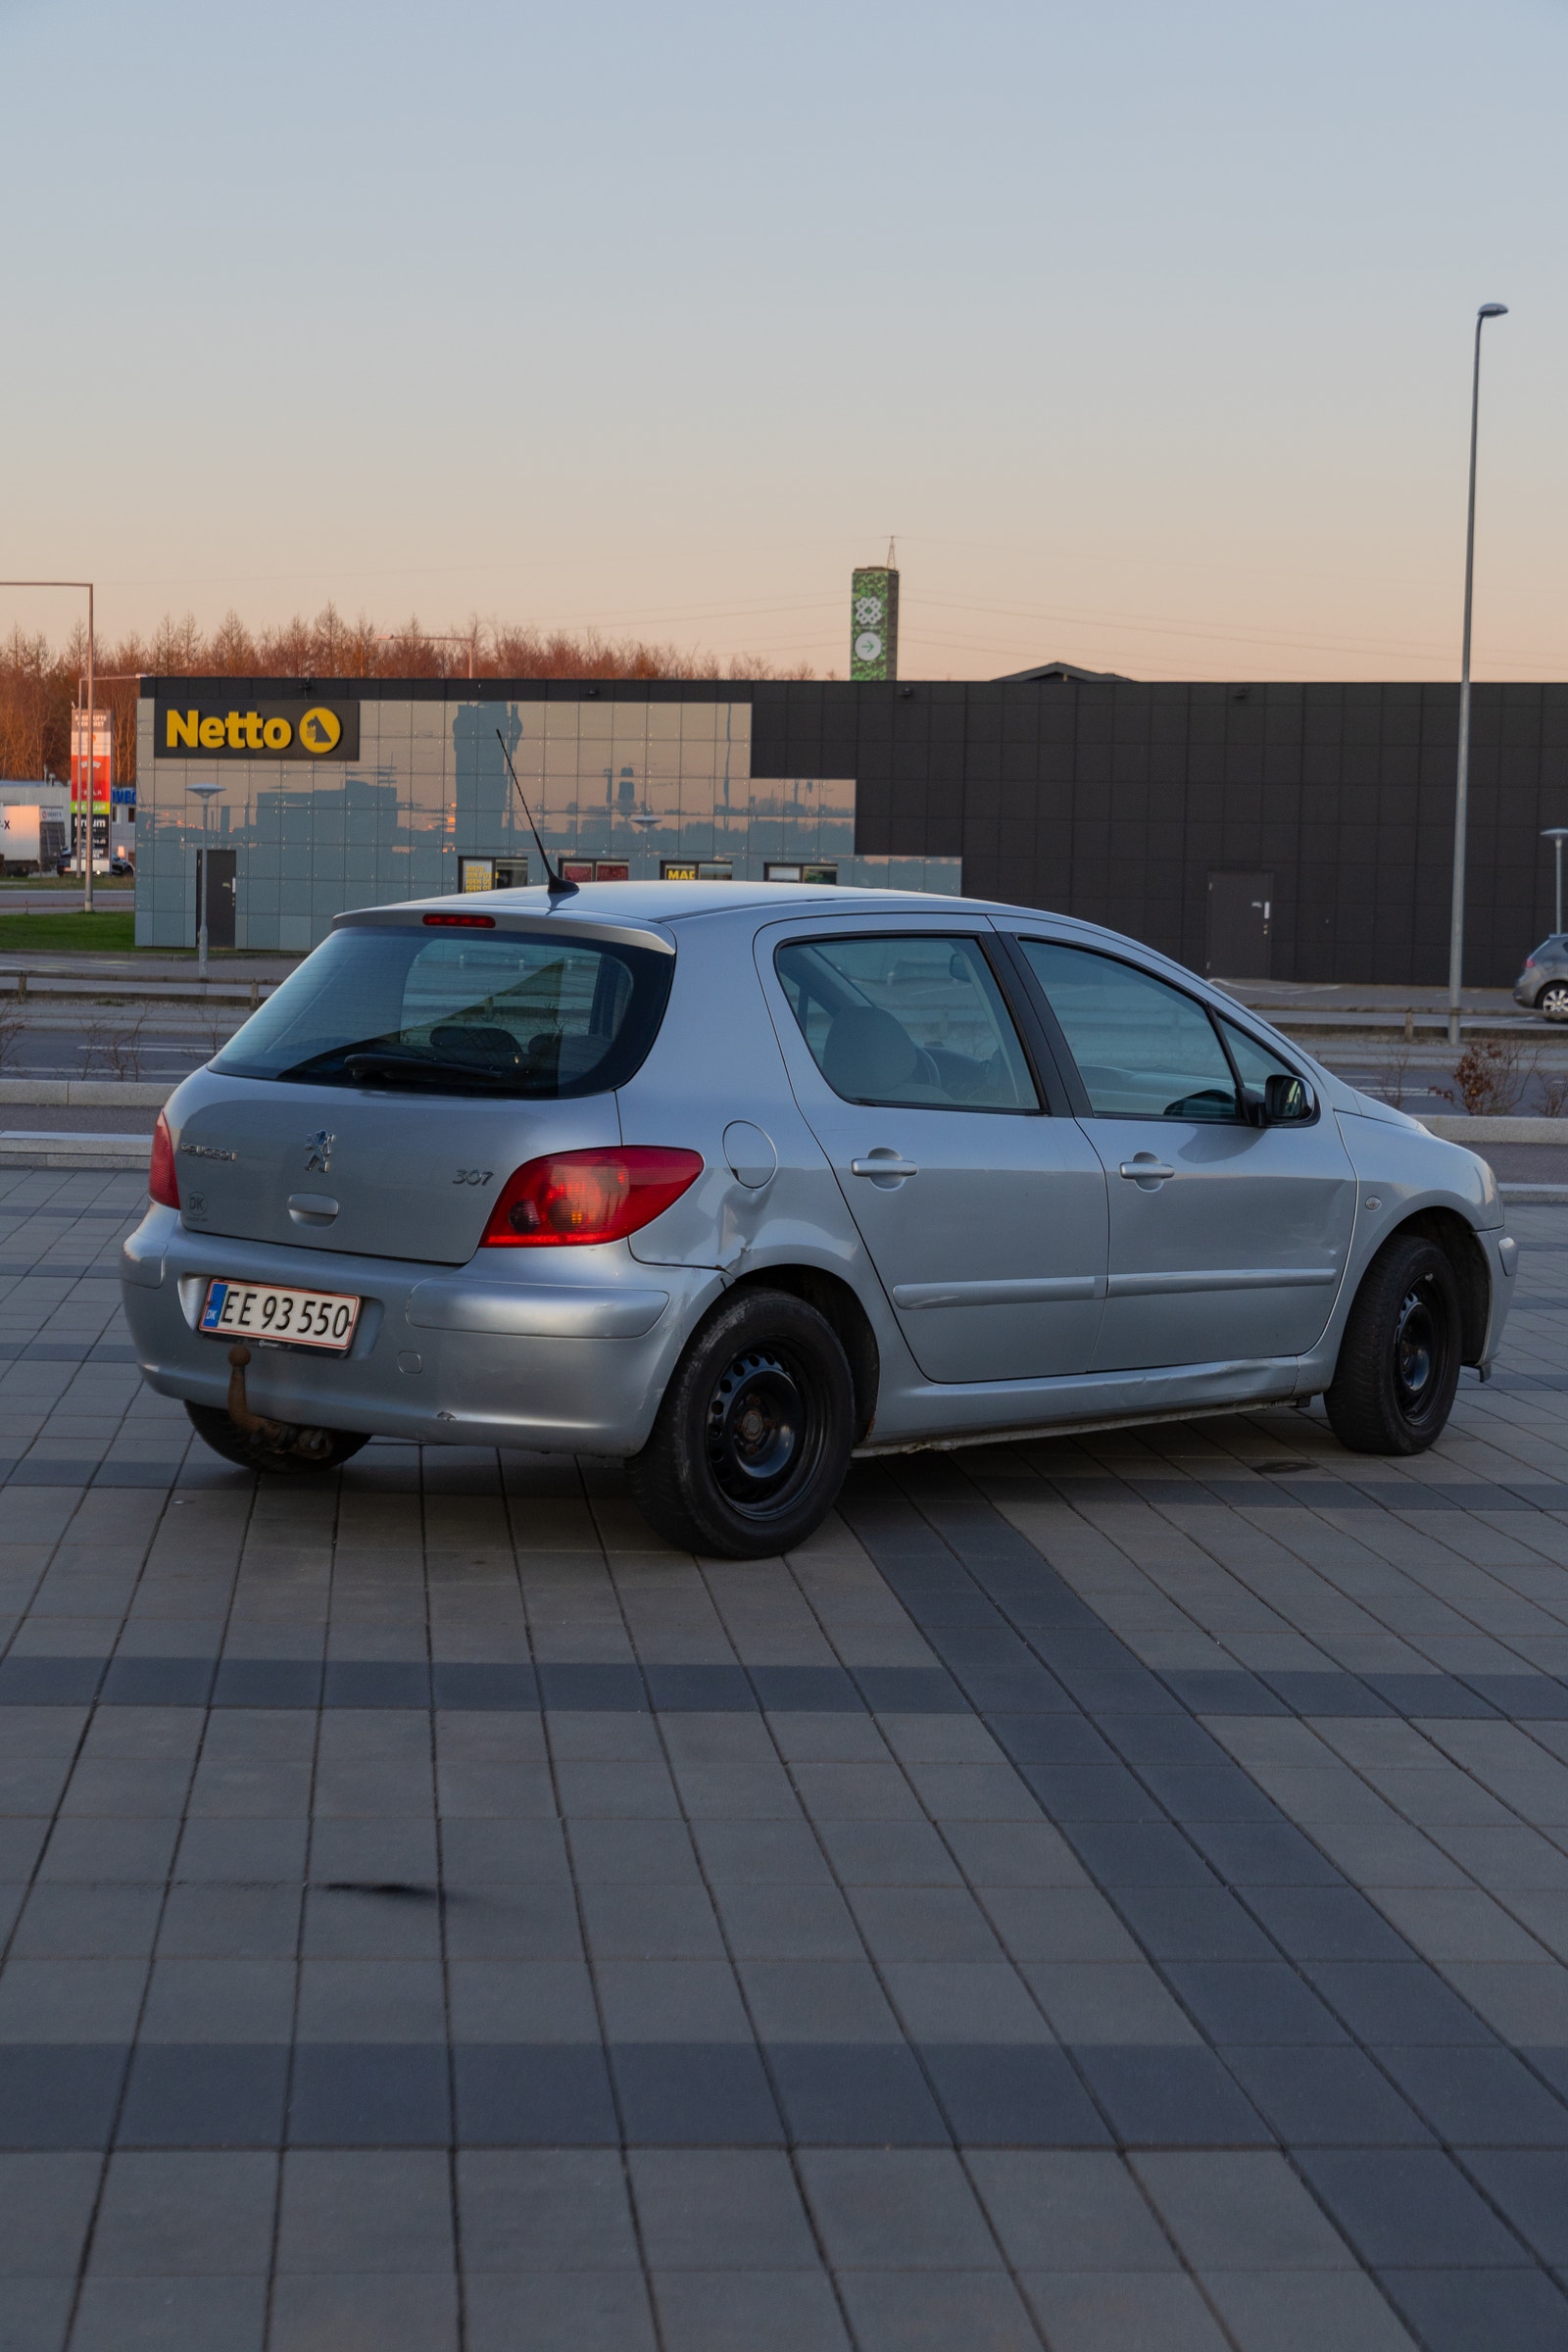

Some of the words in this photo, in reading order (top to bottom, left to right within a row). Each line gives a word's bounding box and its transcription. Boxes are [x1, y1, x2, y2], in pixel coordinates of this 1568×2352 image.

[166, 709, 292, 750] Netto
[452, 1169, 495, 1186] 307
[189, 1197, 205, 1211] DK
[206, 1309, 217, 1320] DK
[220, 1291, 257, 1327] EE
[262, 1296, 294, 1331] 93
[297, 1299, 350, 1339] 550
